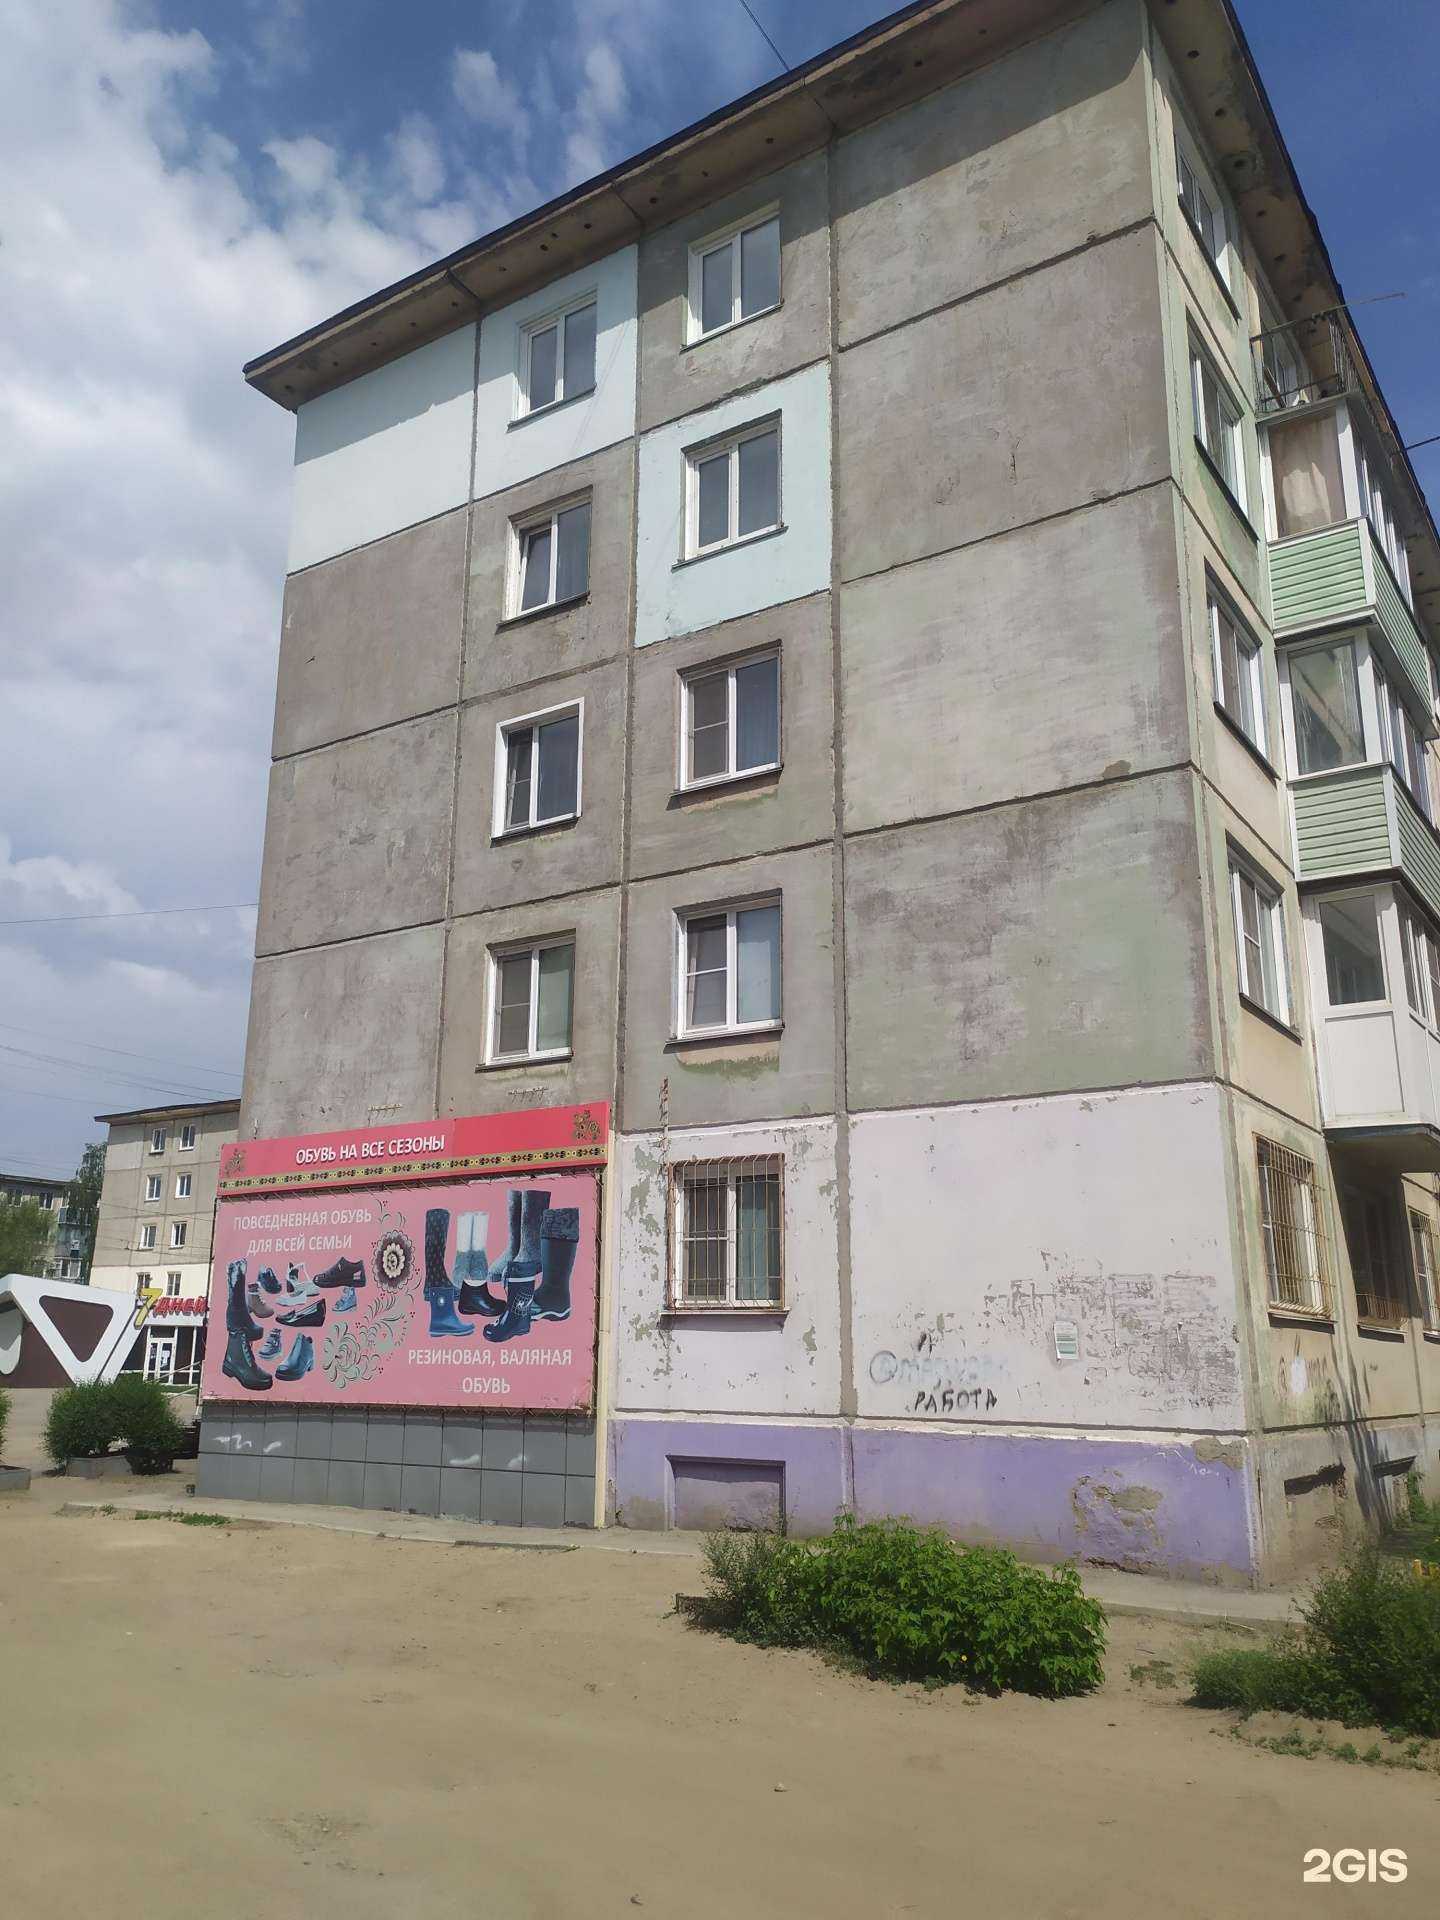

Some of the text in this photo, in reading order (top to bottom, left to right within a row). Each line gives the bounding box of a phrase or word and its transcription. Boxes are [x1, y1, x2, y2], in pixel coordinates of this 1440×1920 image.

[296, 1135, 446, 1165] ОБУВЬ НА ВСЕ СЕЗОНЫ
[233, 1208, 372, 1231] ПОВСЕДНЕВНАЯ ОБУВЬ
[247, 1233, 353, 1256] ДЛЯ ВСЕЙ СЕМЬИ
[134, 1288, 207, 1330] 7 ДНЕЙ
[408, 1348, 572, 1367] РЕЗИНОВАЯ, ВАЛЯНАЯ
[462, 1376, 511, 1394] ОБУВЬ
[914, 1388, 998, 1414] РАБОТА
